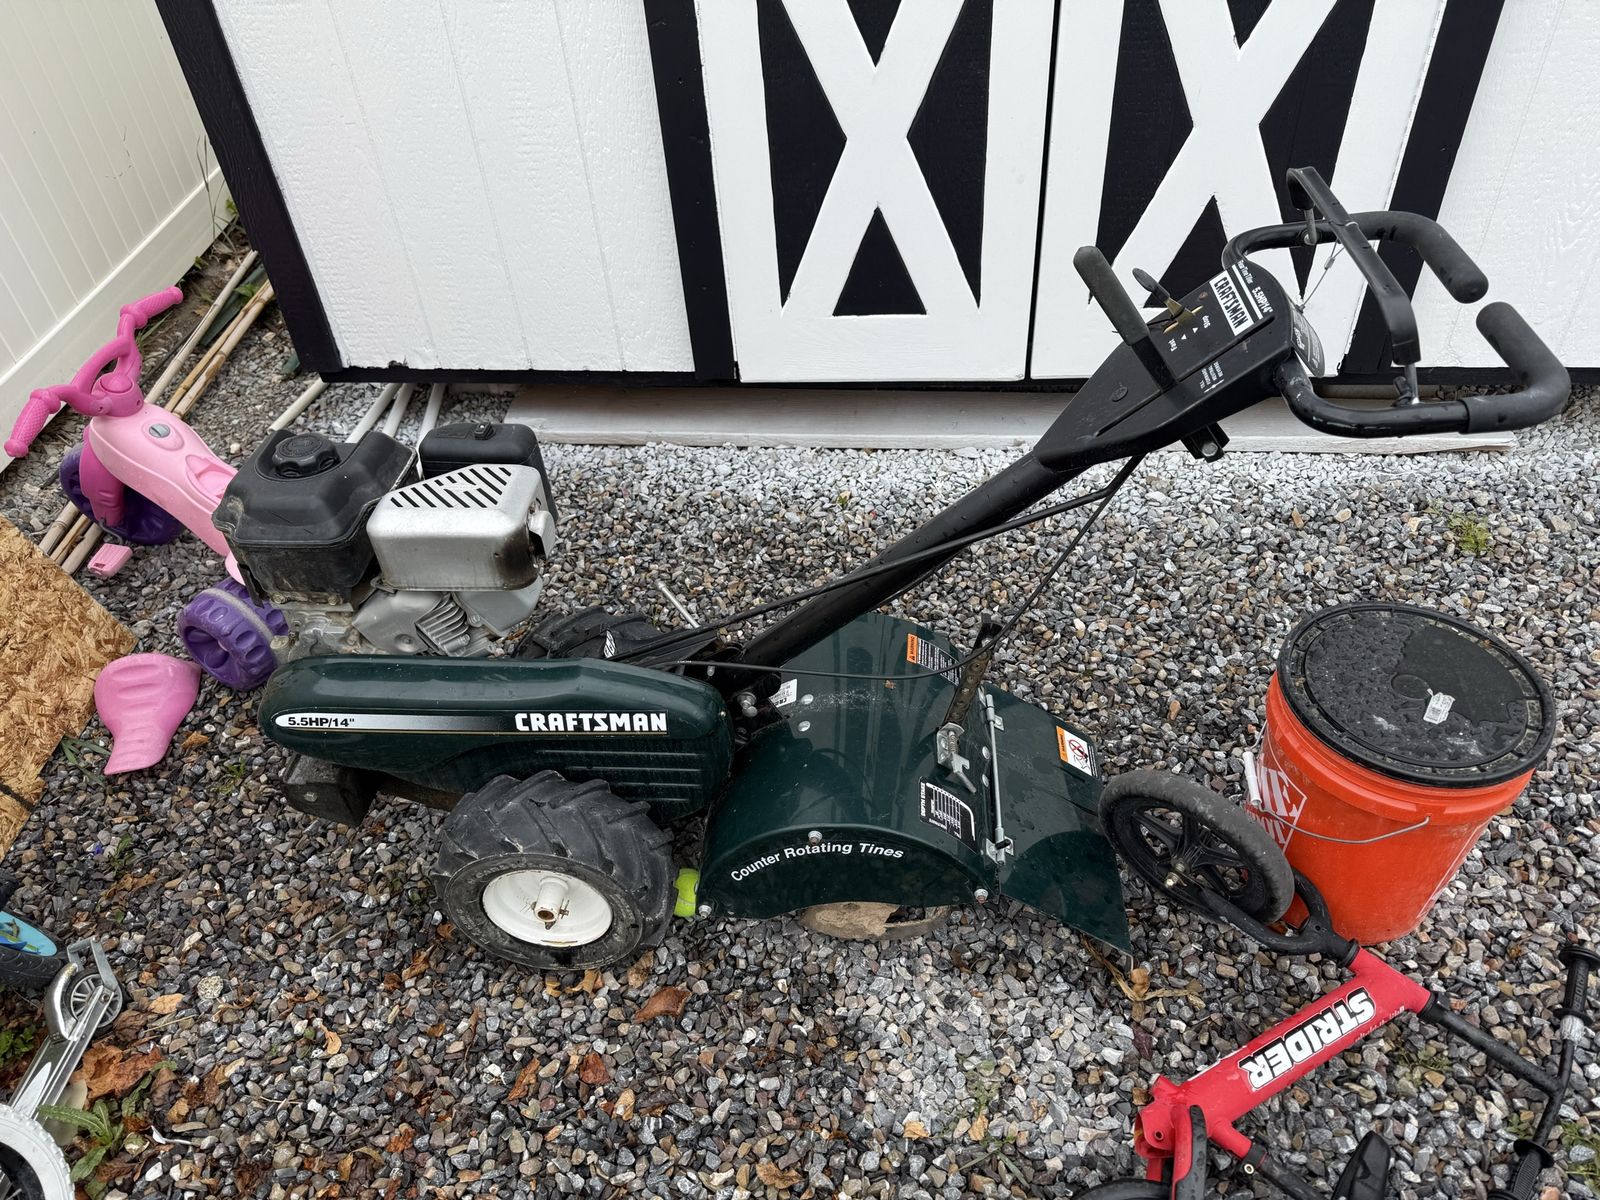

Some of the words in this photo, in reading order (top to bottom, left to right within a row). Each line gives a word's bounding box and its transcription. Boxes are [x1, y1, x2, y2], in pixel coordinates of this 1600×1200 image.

[1213, 276, 1249, 329] CRAFTSMAN
[1202, 315, 1211, 329] Stop
[1168, 338, 1178, 352] Fast
[287, 716, 355, 728] 5.5HP/14"
[514, 713, 668, 731] CRAFTSMAN
[730, 852, 781, 882] Counter
[784, 842, 853, 859] Rotating
[859, 842, 904, 859] Tines
[1239, 988, 1376, 1089] STRIDER
